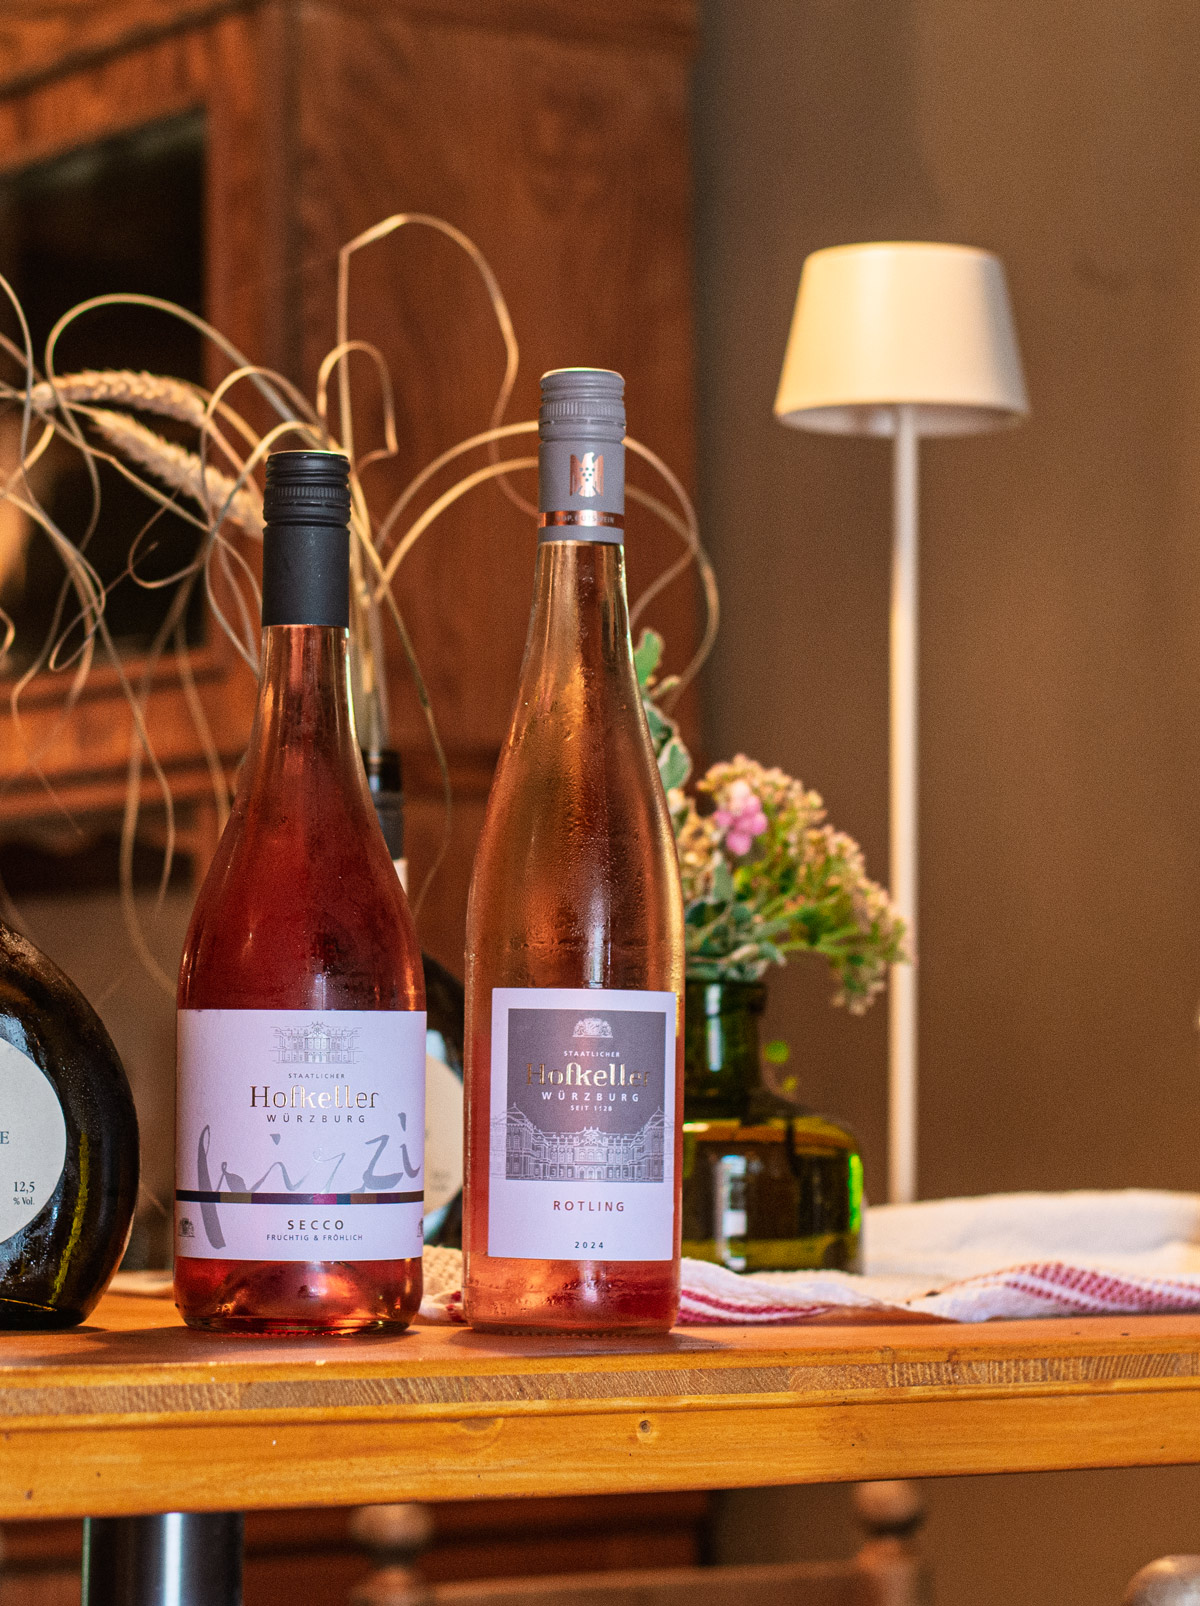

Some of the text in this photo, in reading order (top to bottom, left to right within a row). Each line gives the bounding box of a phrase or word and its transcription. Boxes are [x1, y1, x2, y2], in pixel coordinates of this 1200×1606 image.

[563, 1050, 620, 1058] STAATLICHER
[526, 1062, 650, 1087] Hofkeller
[250, 1085, 379, 1109] Hofkeller
[541, 1090, 639, 1102] WÜRZBURG
[266, 1113, 365, 1123] WÜRZBURG
[13, 1181, 35, 1195] 12,5
[13, 1197, 35, 1206] % Vol.
[553, 1200, 625, 1212] ROTLING
[287, 1219, 344, 1230] SECCO
[323, 1233, 363, 1241] FRÖHLICH
[574, 1241, 604, 1249] 2024
